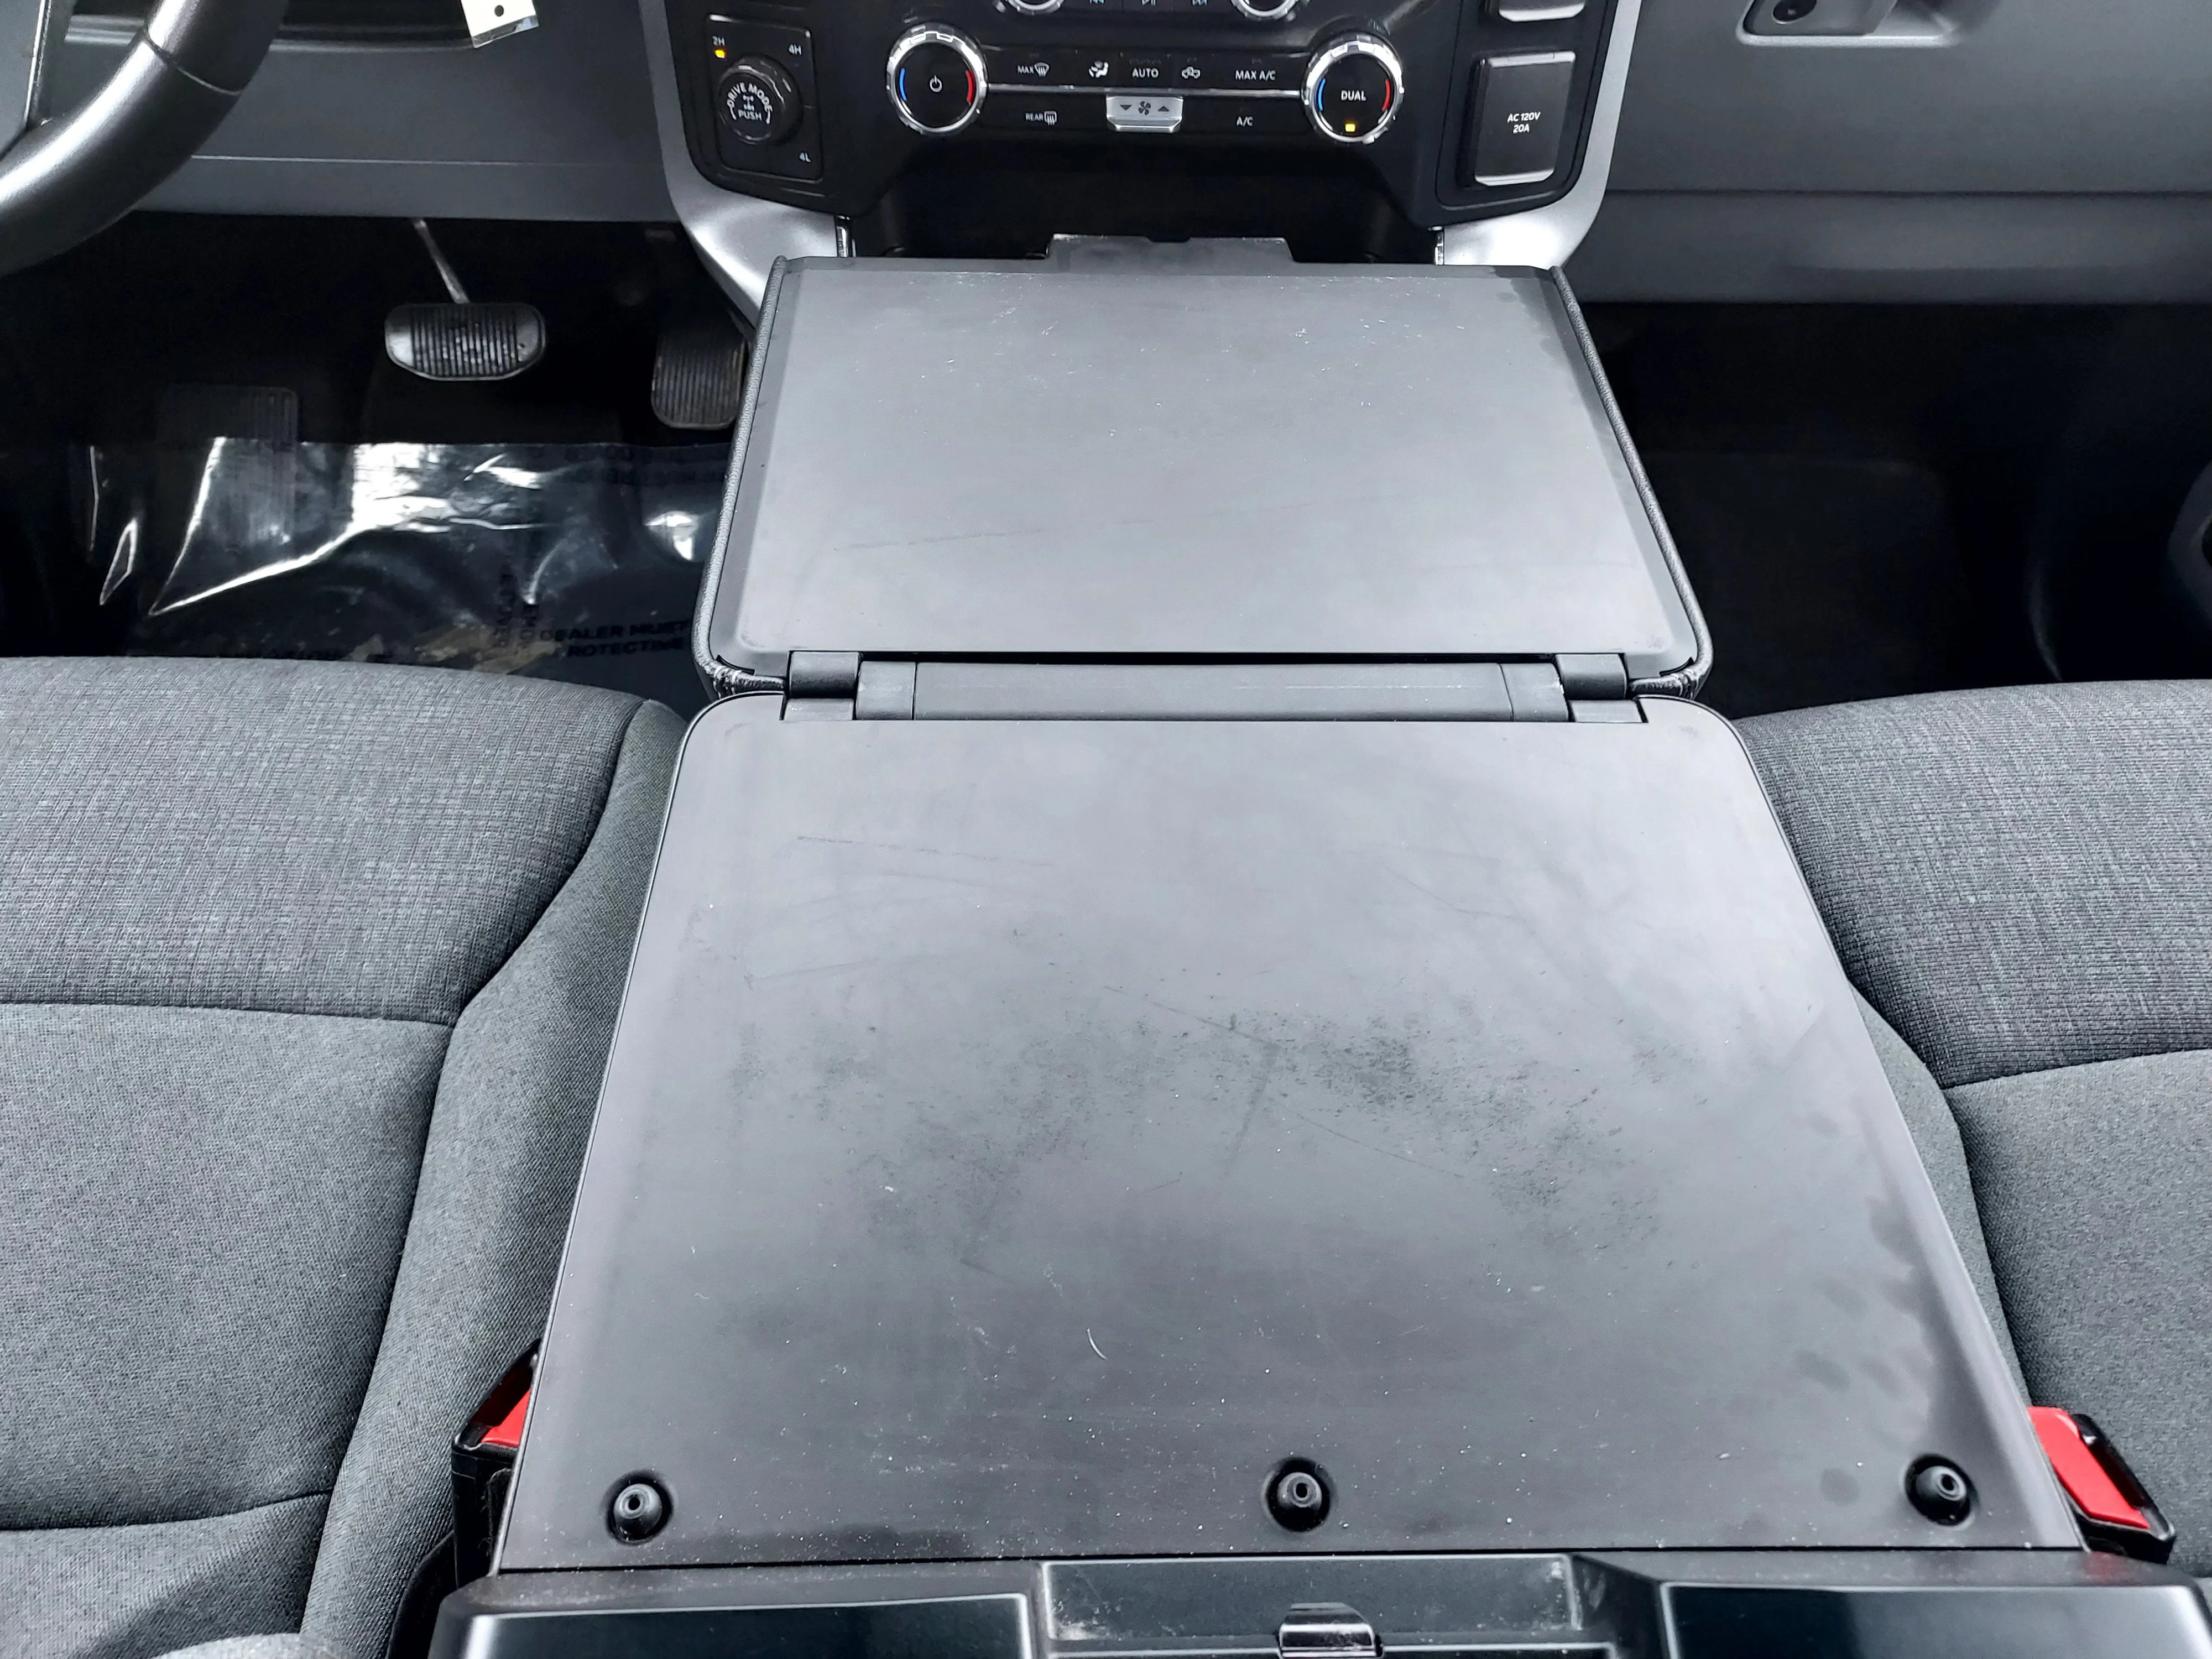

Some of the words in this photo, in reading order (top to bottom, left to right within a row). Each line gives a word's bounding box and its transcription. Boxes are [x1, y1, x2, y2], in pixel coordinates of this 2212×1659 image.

[712, 36, 726, 46] 2H
[788, 44, 802, 55] 4H
[1018, 65, 1034, 74] MAX
[1132, 67, 1159, 78] AUTO
[1235, 70, 1257, 80] MAX
[1259, 70, 1276, 81] A/C
[726, 82, 747, 109] DRIVE
[748, 83, 773, 112] MODE
[1340, 90, 1366, 101] DUAL
[738, 109, 762, 121] PUSH
[1025, 112, 1044, 122] REAR
[1507, 113, 1520, 123] AC
[1520, 111, 1541, 121] 120V
[1236, 116, 1253, 127] A/C
[1513, 123, 1530, 134] 20A
[799, 152, 811, 163] 4L
[561, 637, 684, 658] ROTECTIVE
